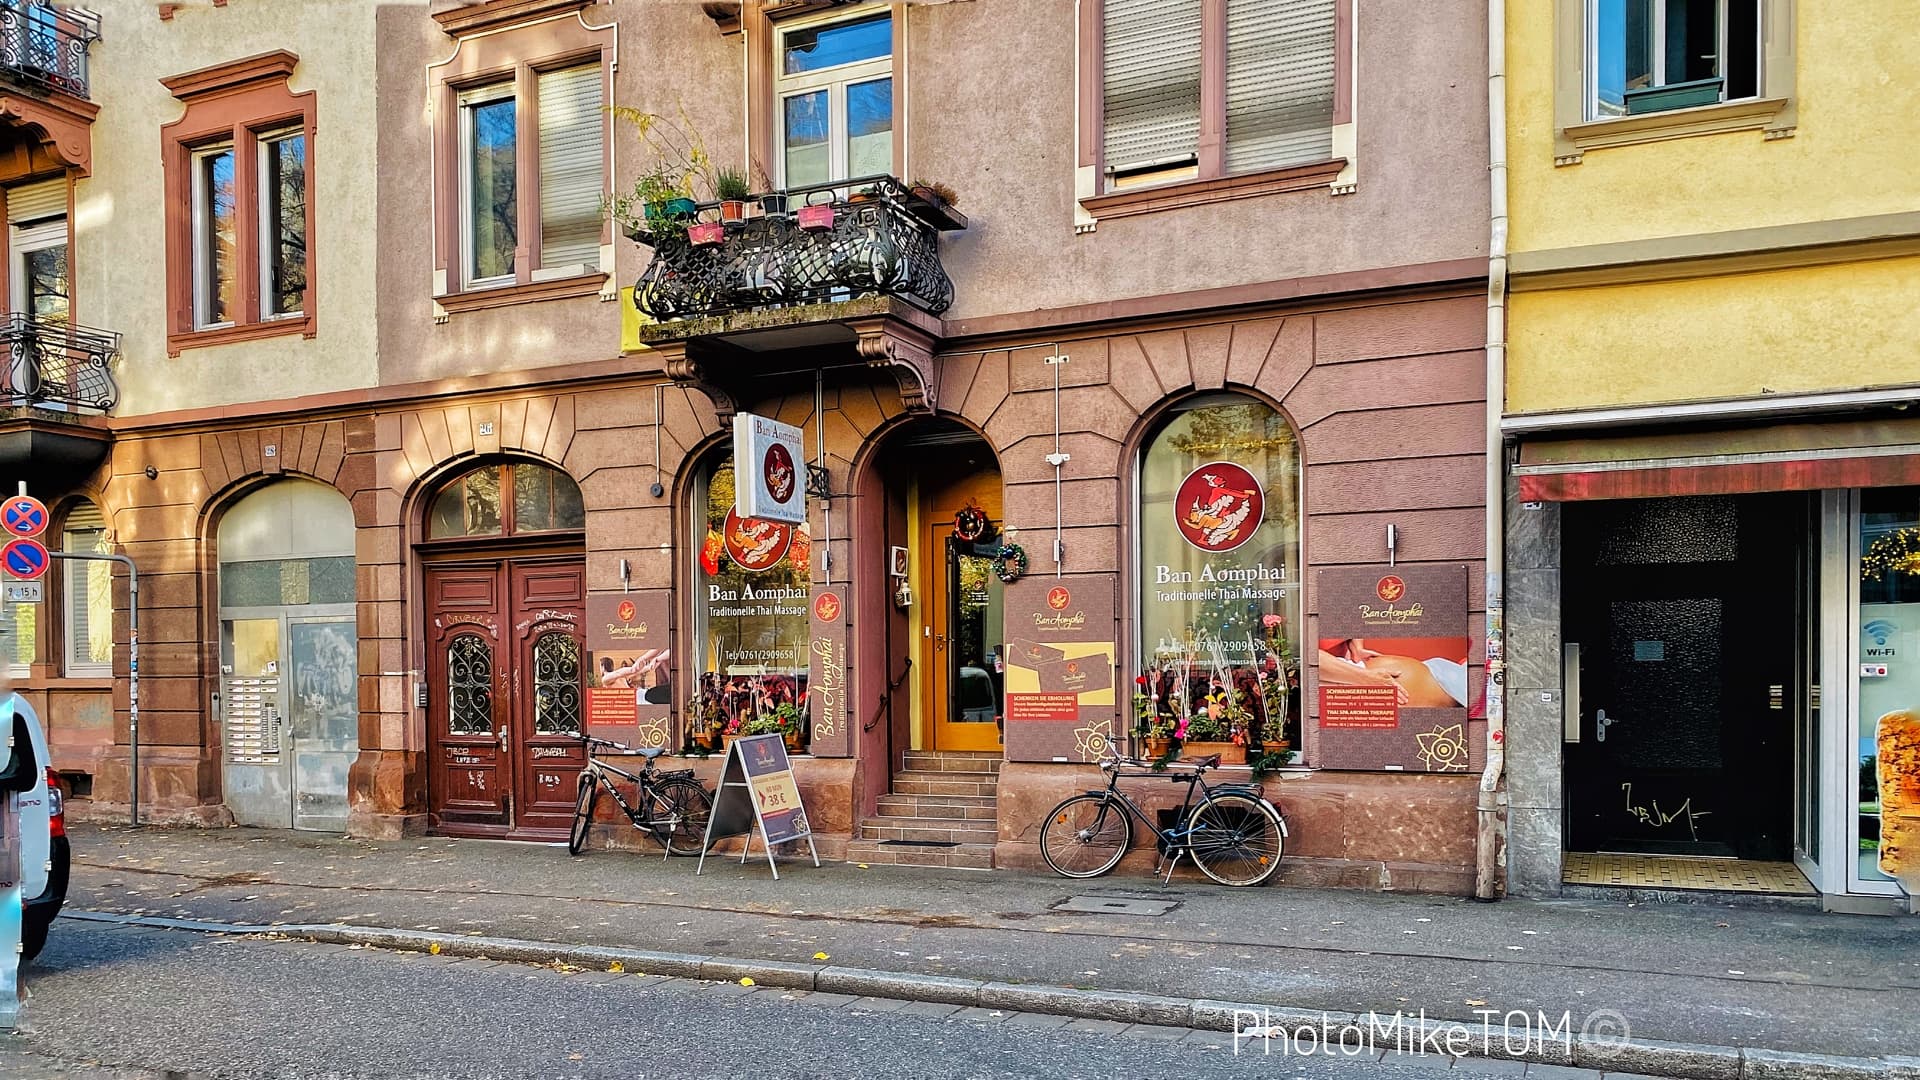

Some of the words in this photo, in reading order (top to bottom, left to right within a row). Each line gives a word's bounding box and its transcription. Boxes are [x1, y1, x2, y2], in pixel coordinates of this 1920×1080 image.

[756, 420, 771, 436] Ban
[772, 424, 802, 446] Aomphai
[1155, 565, 1192, 584] Ban
[1199, 563, 1286, 586] Aomphai
[708, 584, 737, 601] Ban
[741, 583, 807, 604] Aomphai
[1156, 589, 1216, 602] Traditionelle
[1218, 588, 1240, 601] Thai
[1242, 588, 1286, 601] Massage
[709, 606, 755, 617] Traditionelle
[757, 605, 773, 616] Thai
[774, 604, 807, 617] Massage
[1033, 613, 1050, 626] Ban
[1359, 604, 1380, 619] Ban
[1380, 602, 1425, 623] Aomphai
[1866, 648, 1895, 656] Wi-Fi
[811, 636, 843, 706] Aomphai
[814, 707, 835, 741] Ban
[768, 794, 780, 806] 38
